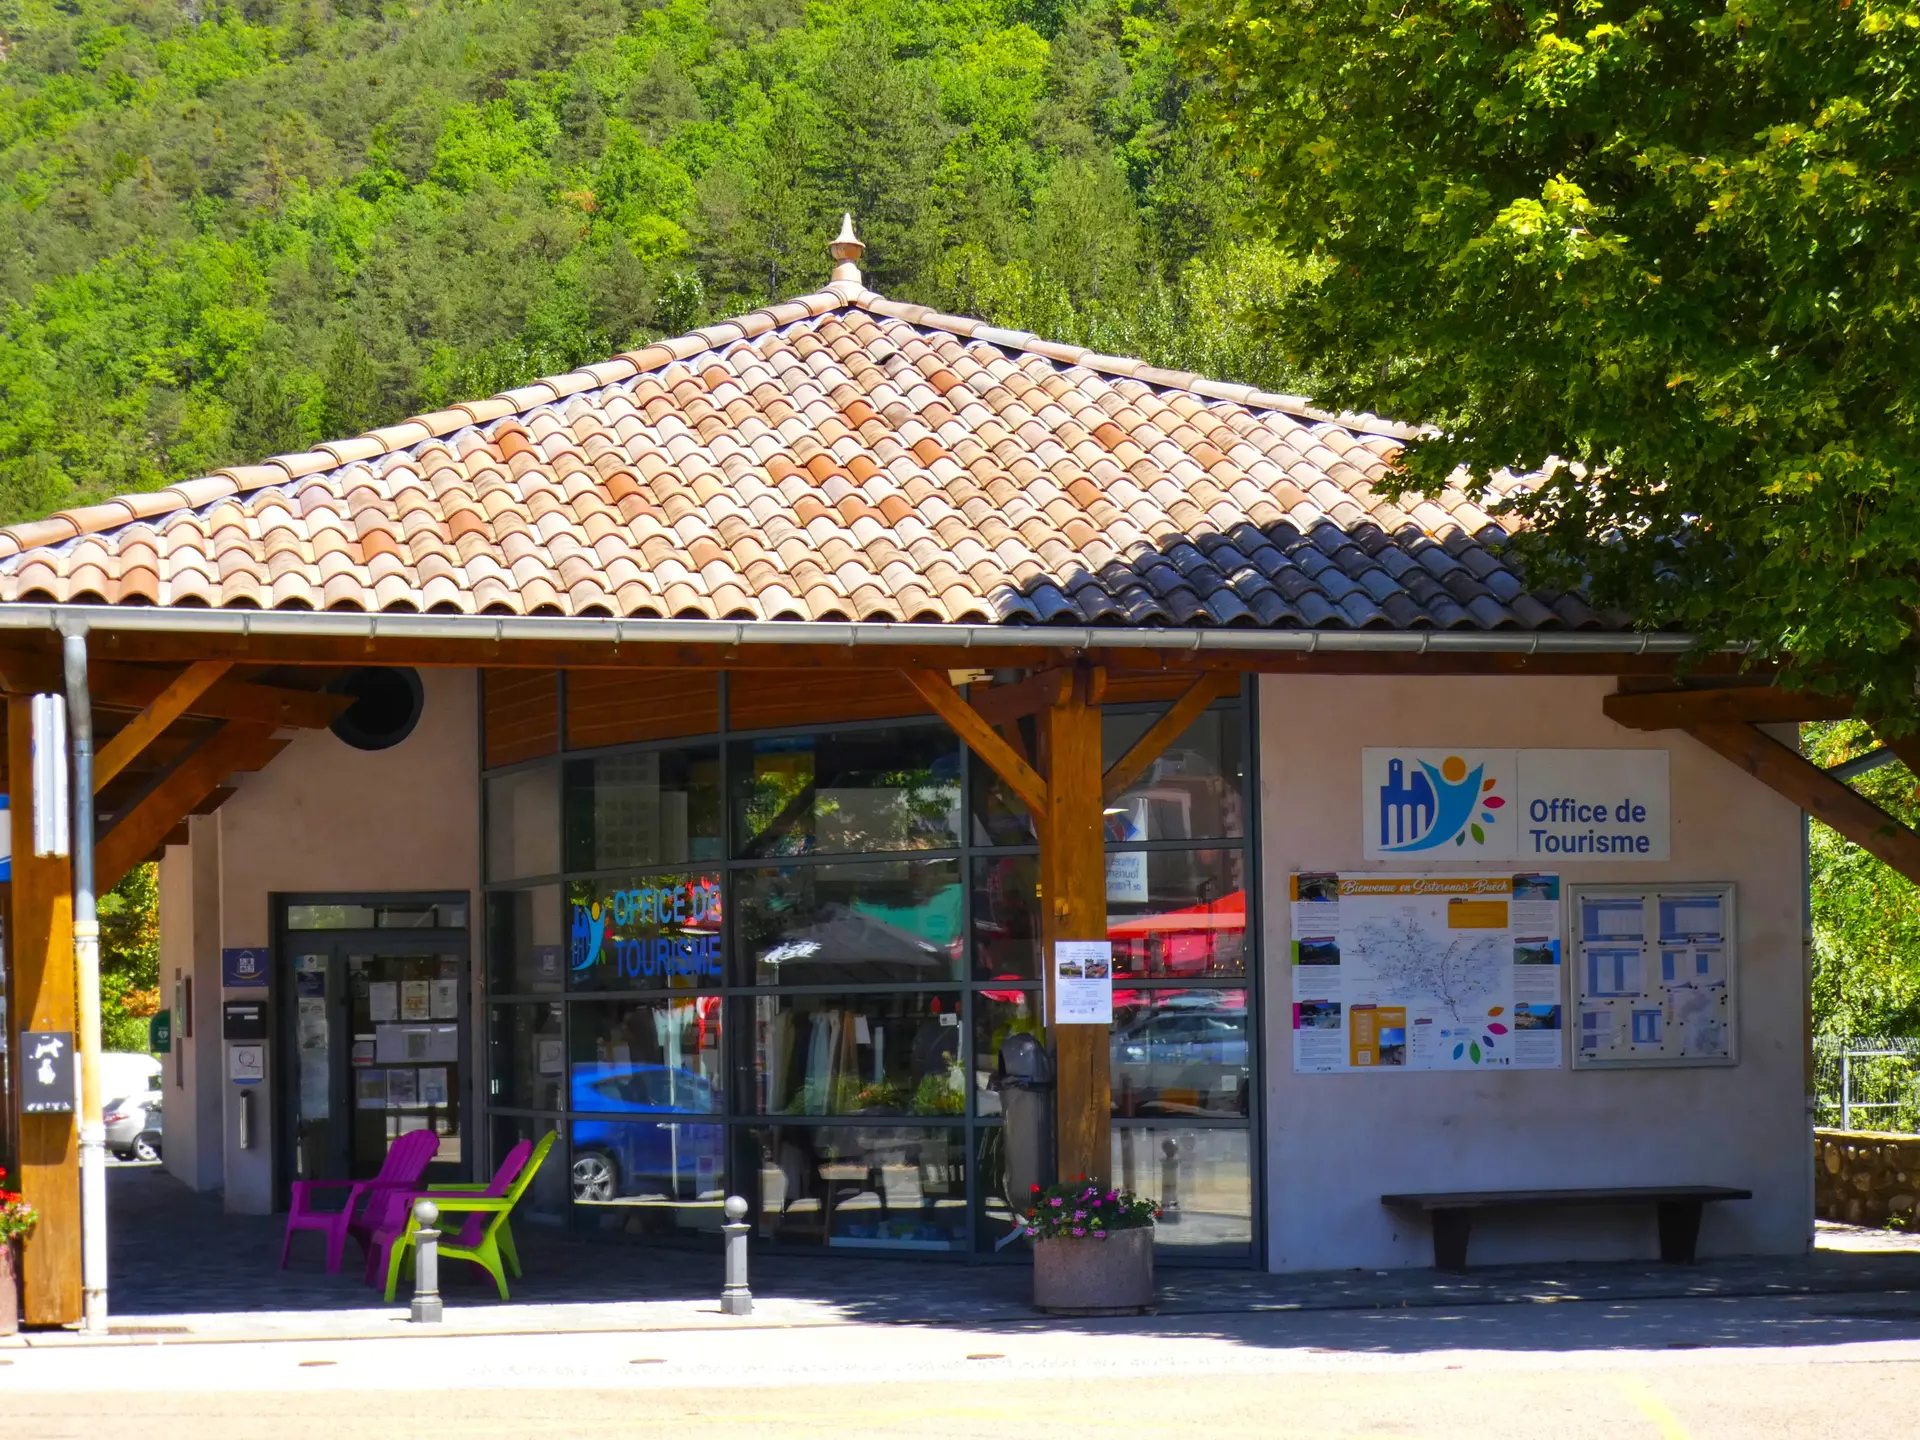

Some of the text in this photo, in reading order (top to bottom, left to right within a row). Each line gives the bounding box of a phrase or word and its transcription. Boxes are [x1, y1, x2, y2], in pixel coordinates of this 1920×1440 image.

[1530, 798, 1646, 823] Office de
[1529, 829, 1650, 853] Tourisme
[1341, 878, 1509, 895] Bienvenue en Sisteronais-Buëch
[615, 886, 722, 926] OFFICE DE
[614, 937, 722, 976] TOURISME
